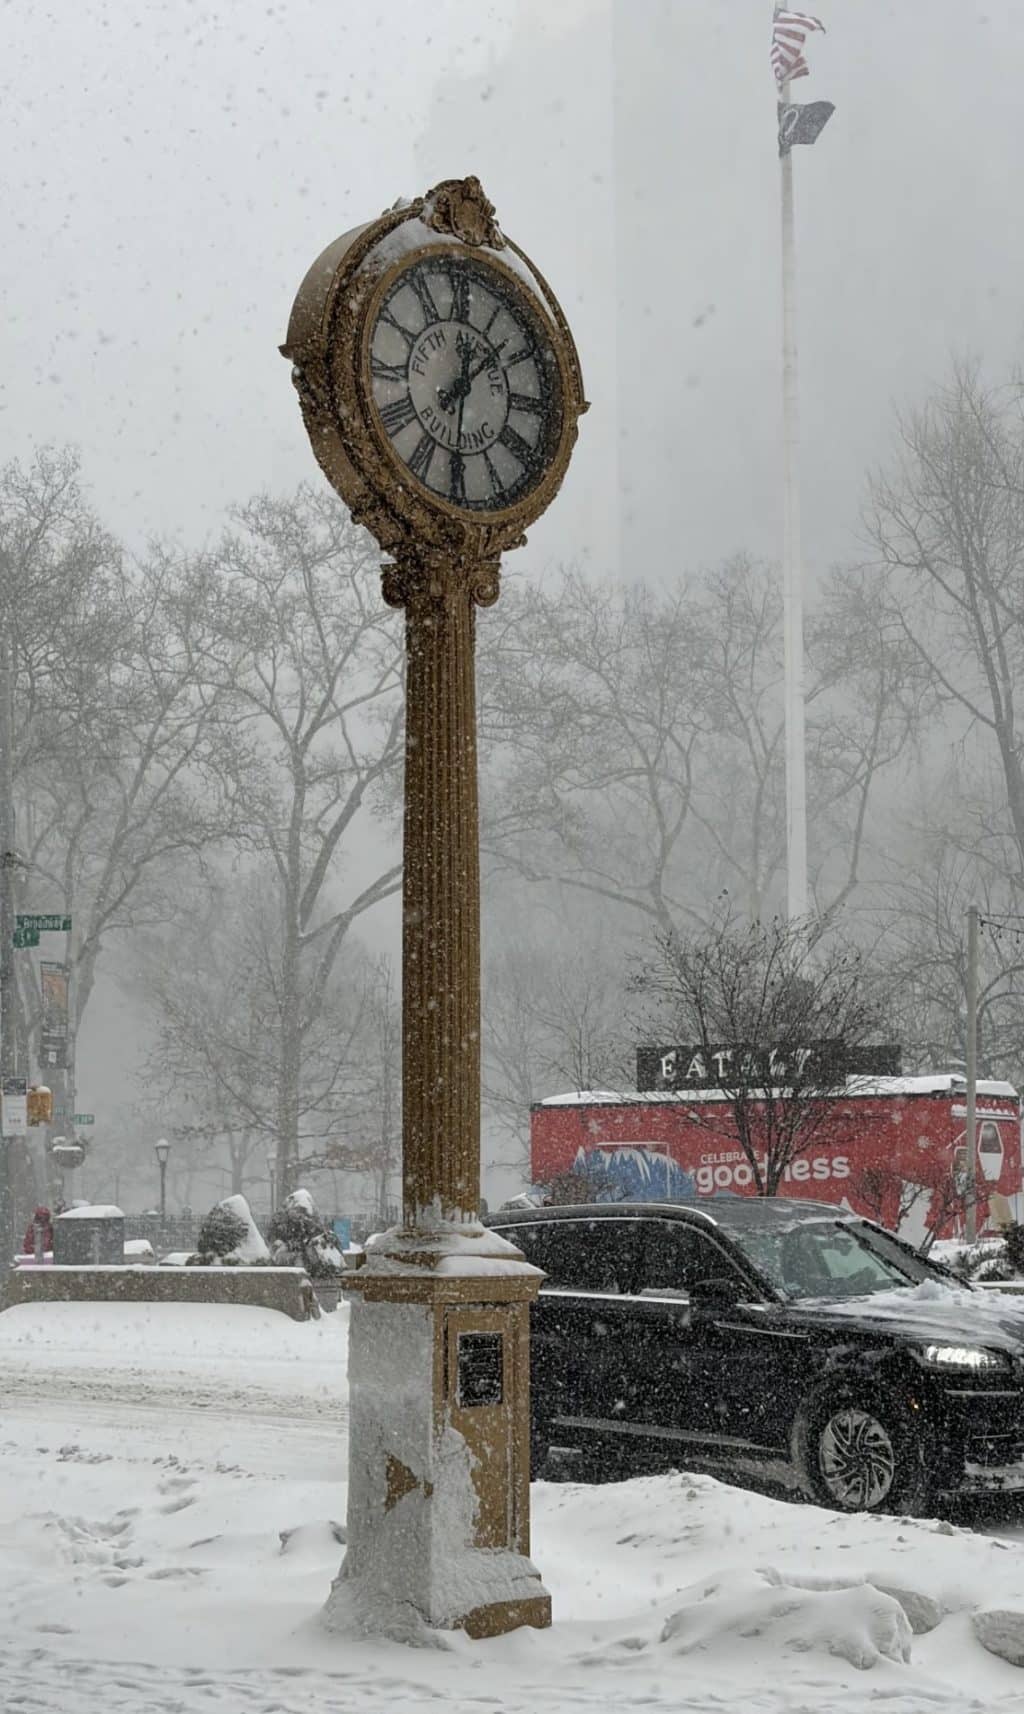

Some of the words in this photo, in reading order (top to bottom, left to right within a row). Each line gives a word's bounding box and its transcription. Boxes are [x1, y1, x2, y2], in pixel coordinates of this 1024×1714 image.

[411, 329, 446, 376] FIFTH
[455, 329, 504, 396] AVEUE
[420, 405, 496, 449] BUILDING
[701, 1151, 760, 1165] CELEBRAE
